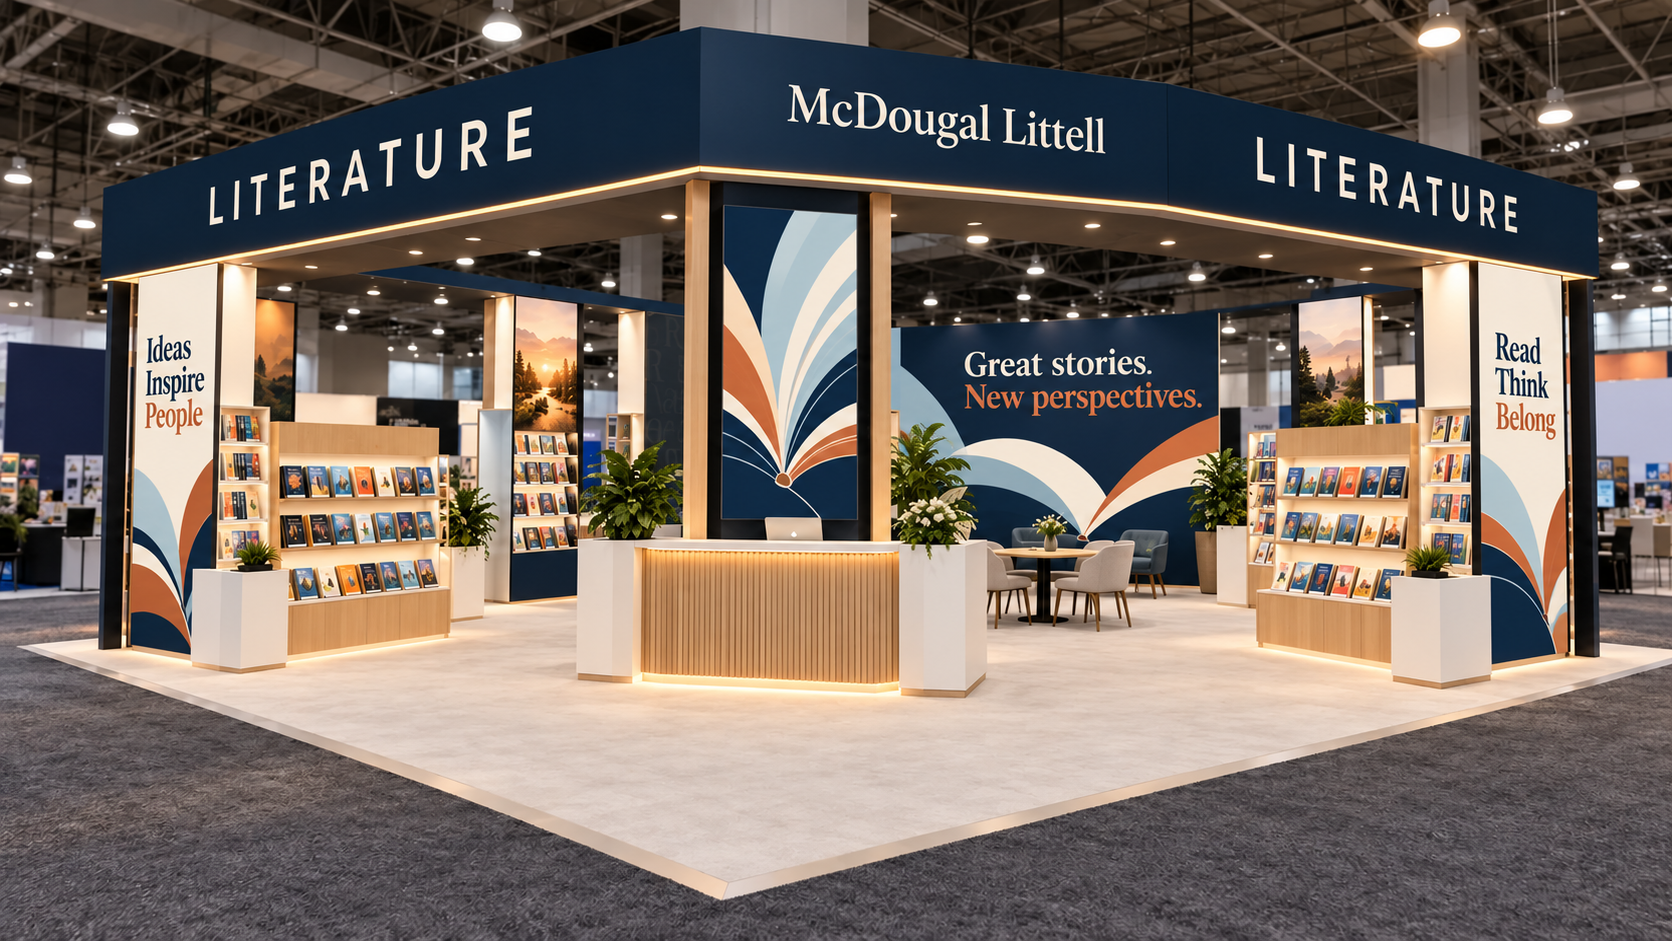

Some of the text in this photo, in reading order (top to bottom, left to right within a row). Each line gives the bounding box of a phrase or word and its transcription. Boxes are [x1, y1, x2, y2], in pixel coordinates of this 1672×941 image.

[787, 84, 1106, 154] McDougal Littell
[209, 106, 533, 226] LITERATURE
[1256, 136, 1519, 234] LITERATURE
[146, 333, 193, 364] Ideas
[964, 348, 1153, 378] Great stories.
[1494, 331, 1542, 364] Read
[145, 365, 205, 402] Inspire
[964, 381, 1203, 417] New perspectives.
[1494, 366, 1549, 399] Think
[144, 397, 204, 436] People
[1495, 401, 1557, 441] Belong
